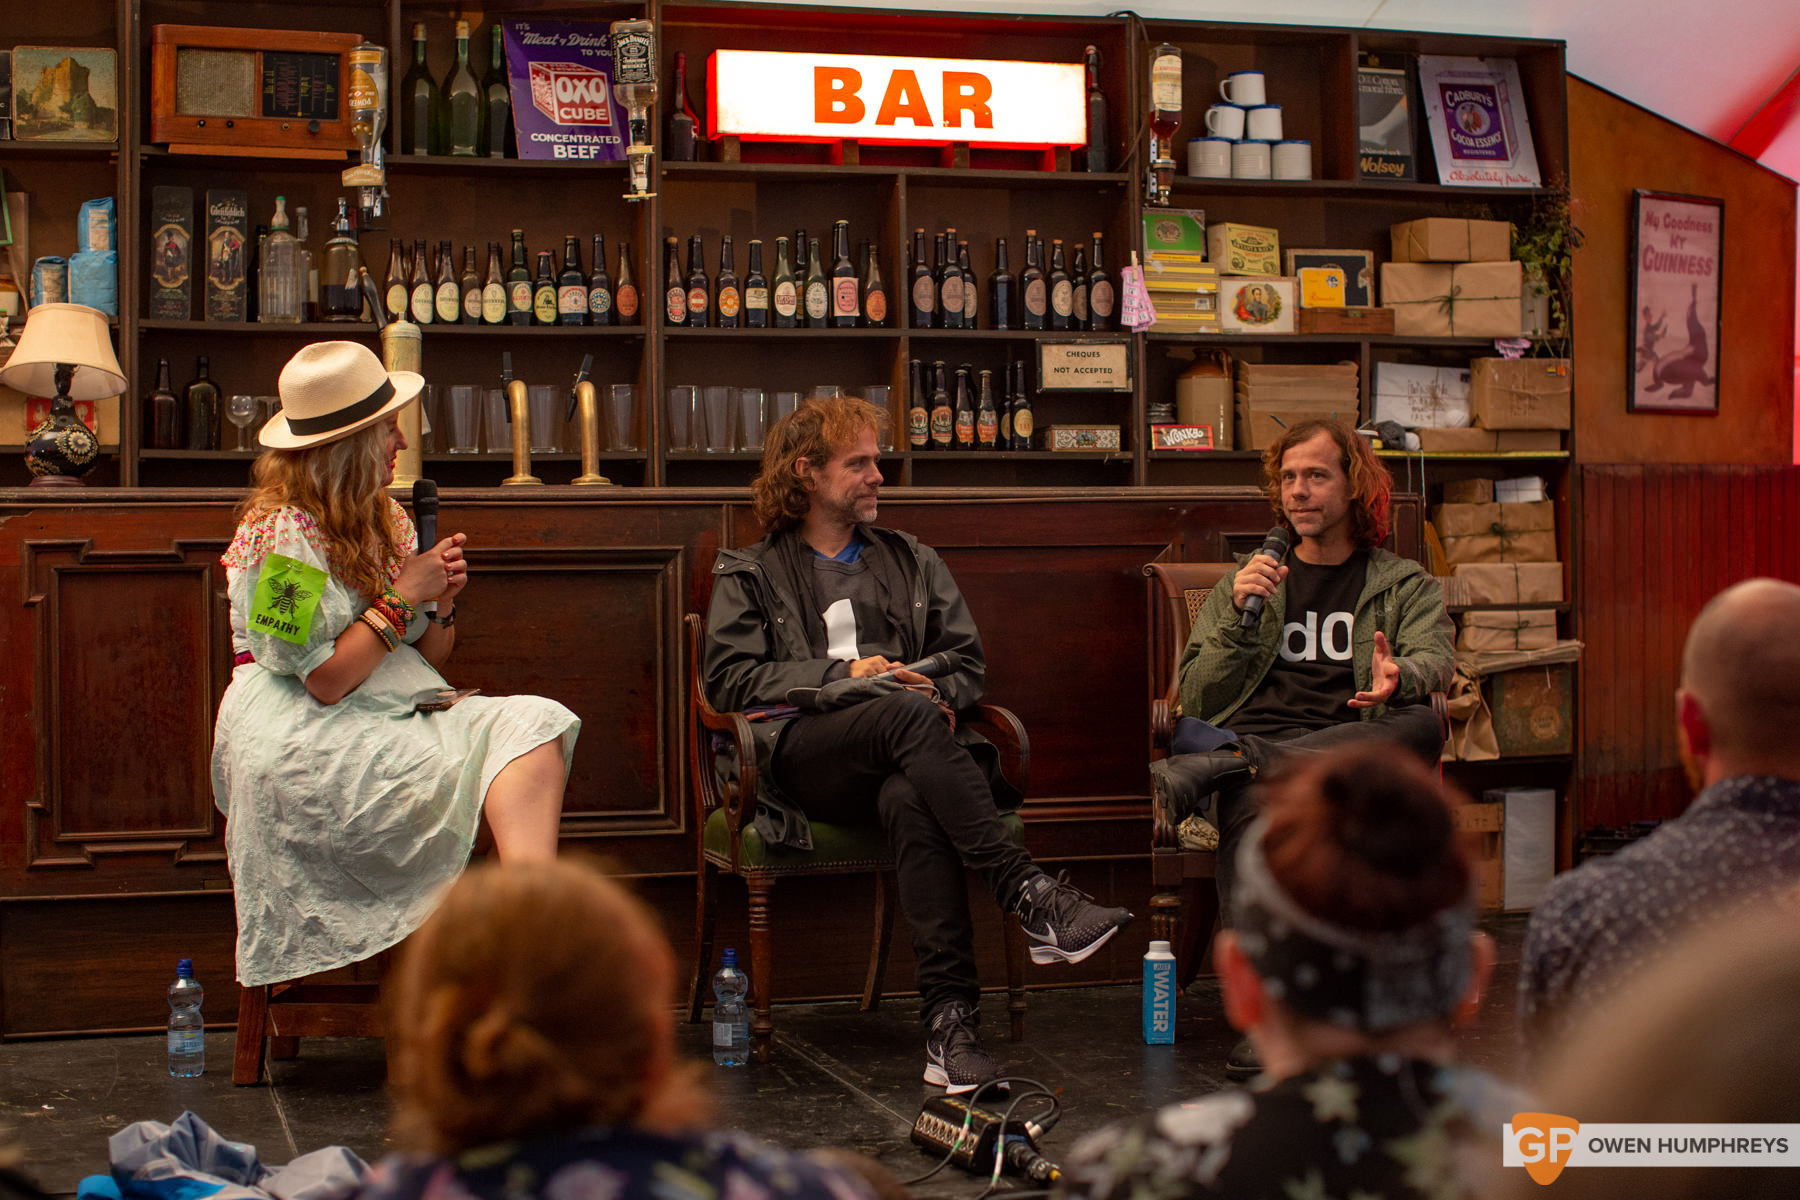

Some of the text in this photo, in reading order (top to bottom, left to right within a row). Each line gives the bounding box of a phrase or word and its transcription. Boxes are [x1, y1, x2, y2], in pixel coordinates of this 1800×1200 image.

[556, 76, 607, 104] OXO
[814, 66, 994, 129] BAR
[1445, 89, 1493, 107] CADBURY'S
[559, 107, 608, 121] CUBE
[530, 132, 621, 144] CONCENTRATED
[1451, 128, 1503, 149] COCOA ESSENCE
[553, 144, 600, 159] BEEF
[1644, 211, 1713, 234] My Goodness
[1642, 244, 1714, 277] GUINNESS
[1066, 351, 1101, 359] CHEQUES
[1163, 427, 1204, 446] WONKA
[255, 613, 301, 636] EMPATHY
[1153, 970, 1170, 1032] WATER
